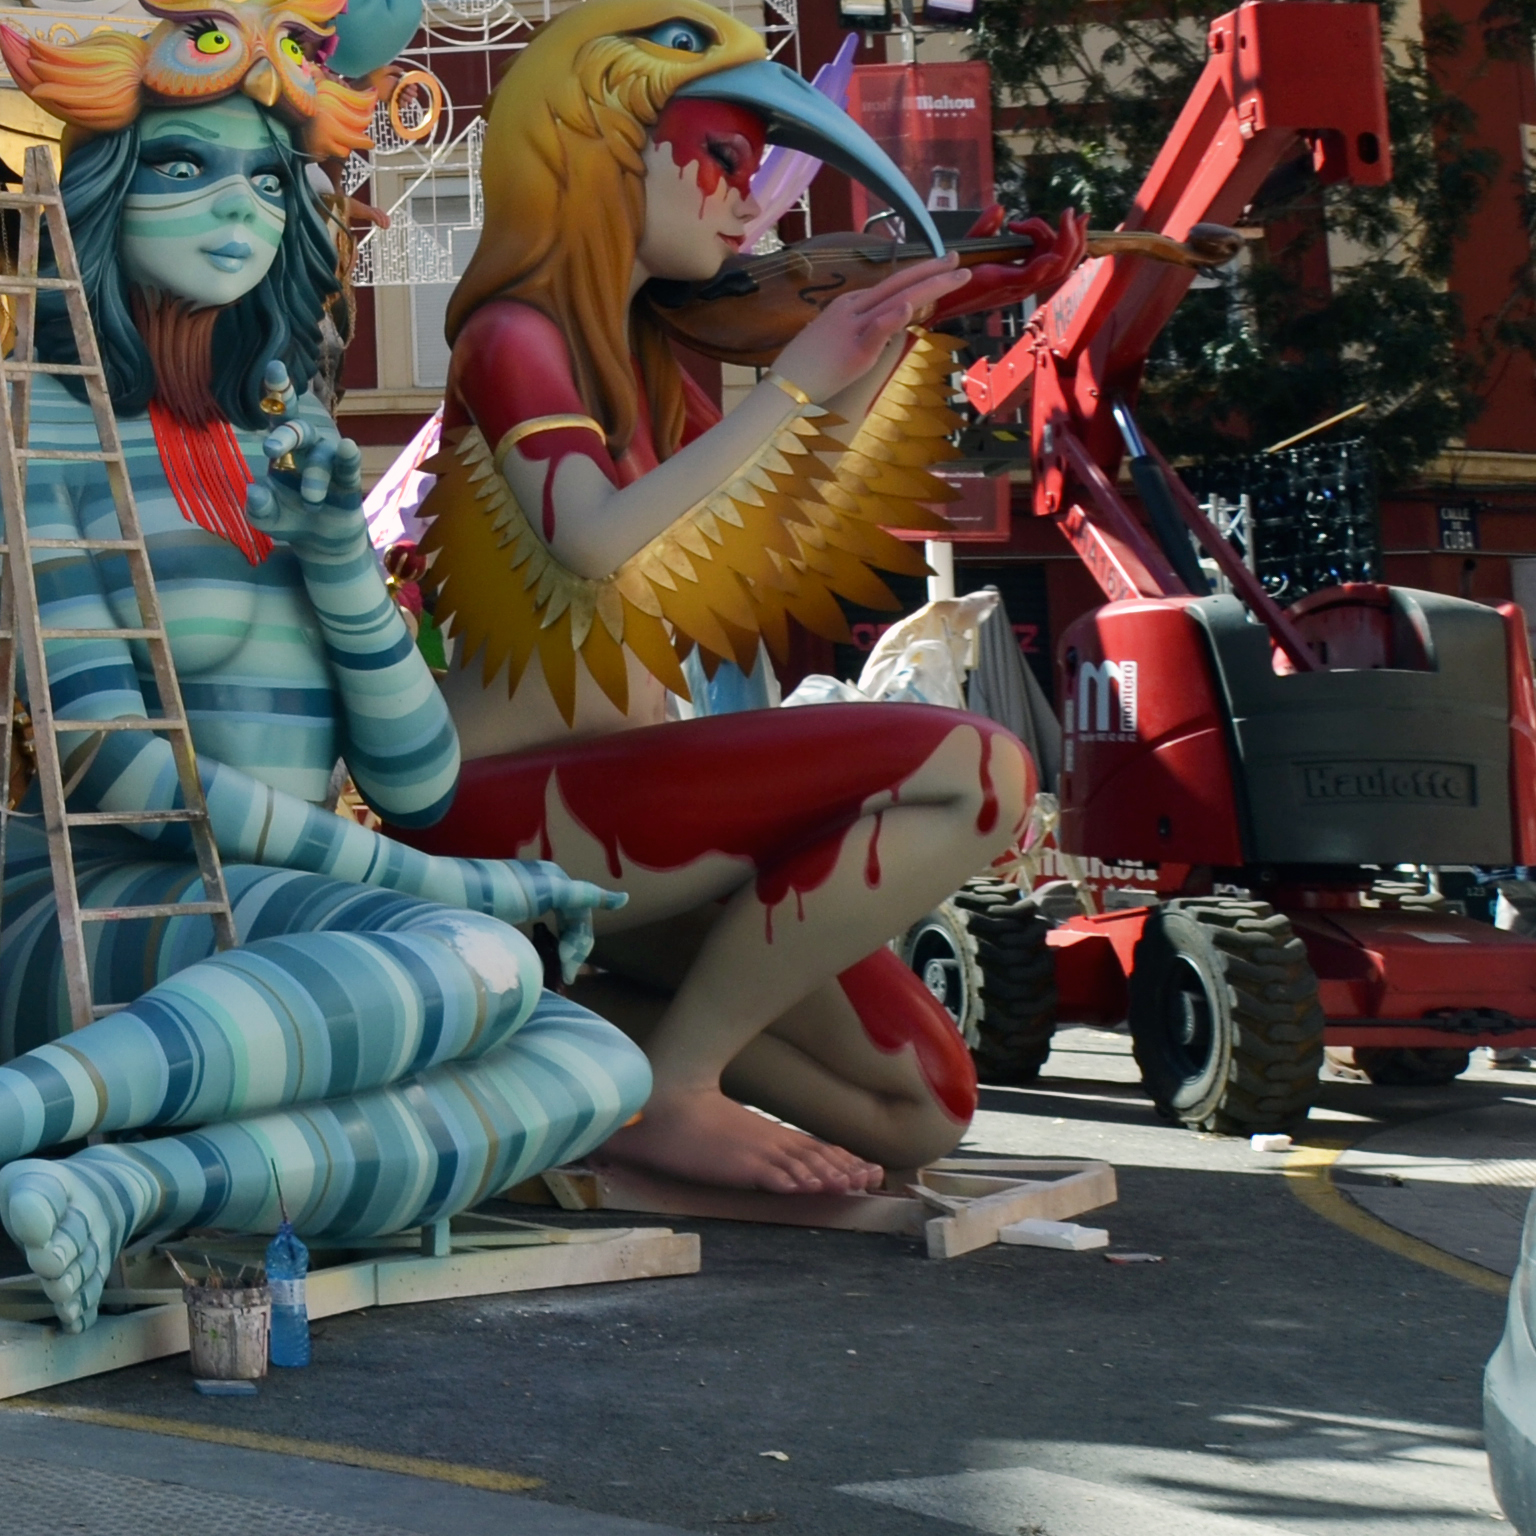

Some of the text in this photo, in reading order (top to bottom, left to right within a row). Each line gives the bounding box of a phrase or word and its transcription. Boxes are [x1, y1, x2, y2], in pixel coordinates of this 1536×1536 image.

[917, 95, 976, 110] Mahou
[1441, 508, 1470, 520] CALLE
[1443, 530, 1473, 550] CUBA
[1123, 664, 1134, 729] montero
[1304, 766, 1466, 799] Haulotte
